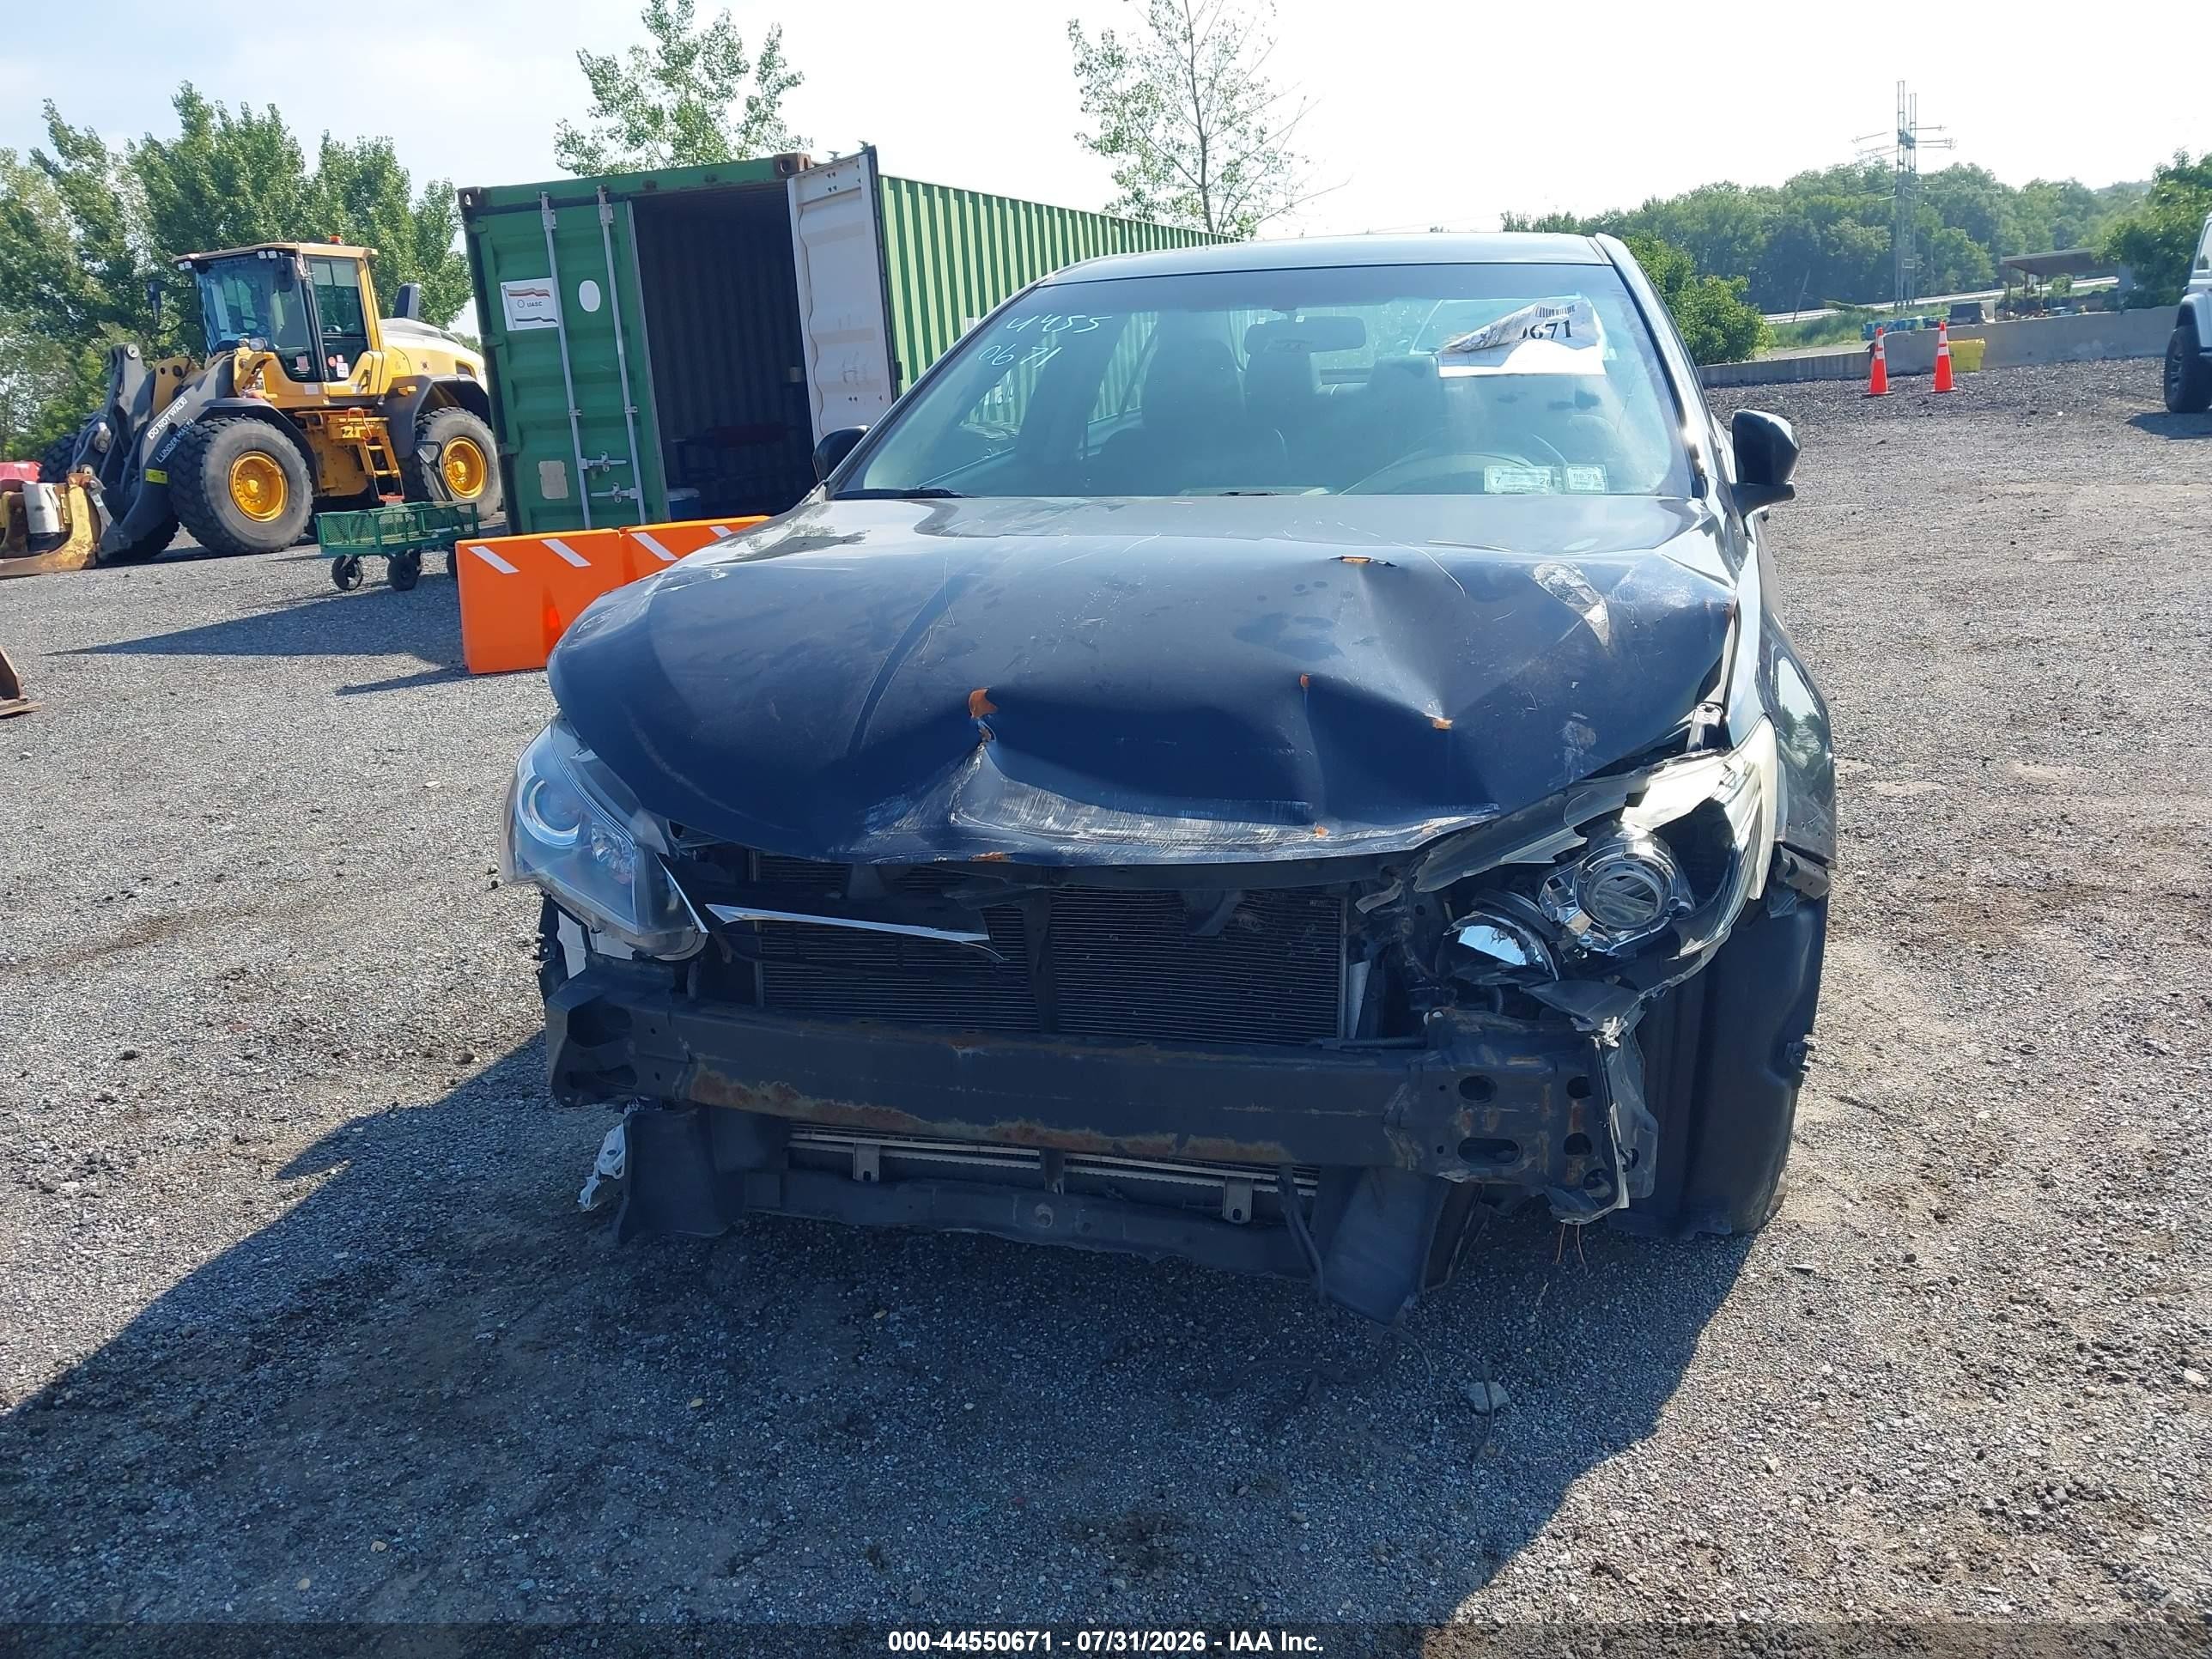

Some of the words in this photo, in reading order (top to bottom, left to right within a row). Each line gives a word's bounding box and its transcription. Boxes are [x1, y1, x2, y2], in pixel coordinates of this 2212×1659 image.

[978, 343, 1063, 369] 0671
[147, 428, 160, 441] DO
[156, 413, 172, 428] NOT
[169, 396, 188, 417] WALK
[160, 436, 179, 458] UNDER
